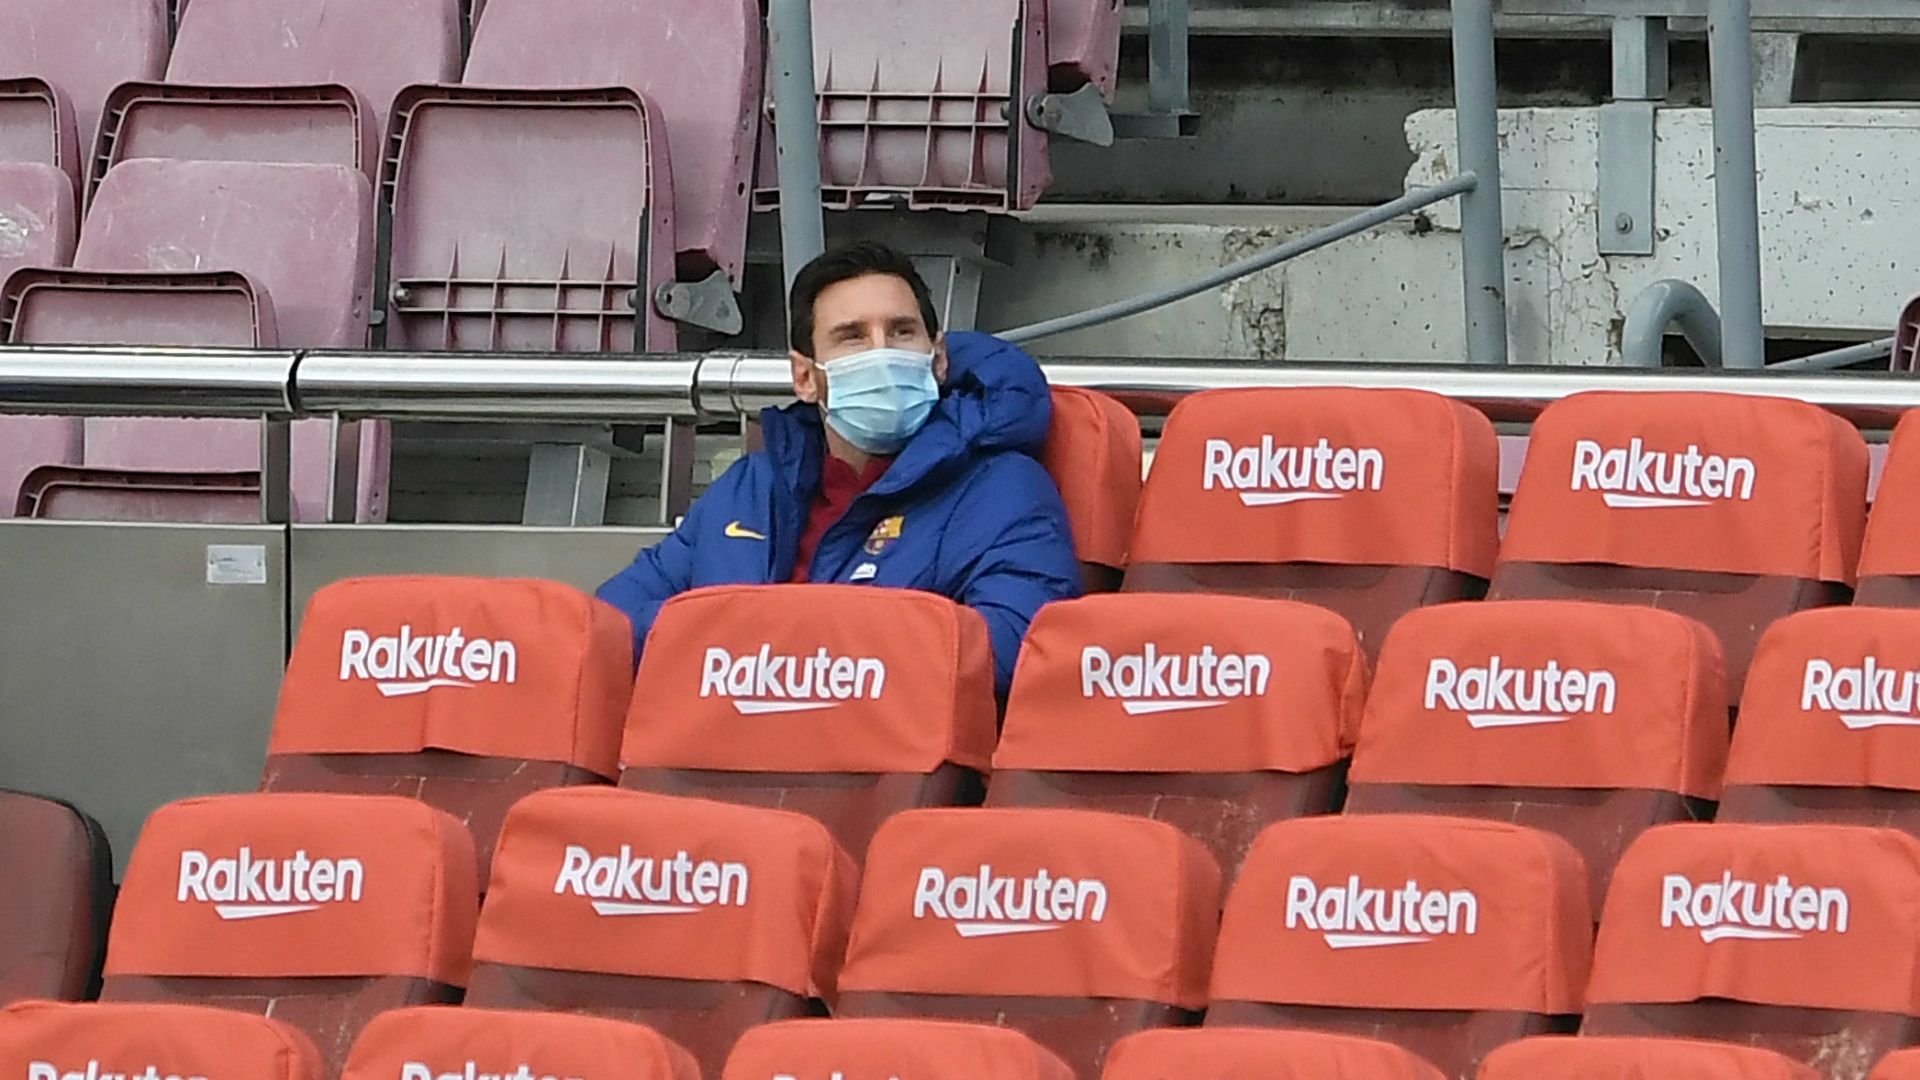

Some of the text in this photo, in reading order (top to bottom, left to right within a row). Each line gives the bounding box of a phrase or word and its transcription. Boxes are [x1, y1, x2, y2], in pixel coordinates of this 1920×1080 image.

[1203, 434, 1384, 490] Rakuten
[1571, 437, 1756, 500] Rakuten
[339, 624, 517, 683] Rakuten
[699, 643, 886, 699] Rakuten
[1081, 643, 1271, 698] Rakuten
[1424, 655, 1616, 714] Rakuten
[177, 846, 364, 902] Rakuten
[554, 844, 748, 906] Rakuten
[913, 864, 1108, 922] Rakuten
[1660, 870, 1849, 933] Rakuten
[1285, 874, 1478, 934] Rakuten
